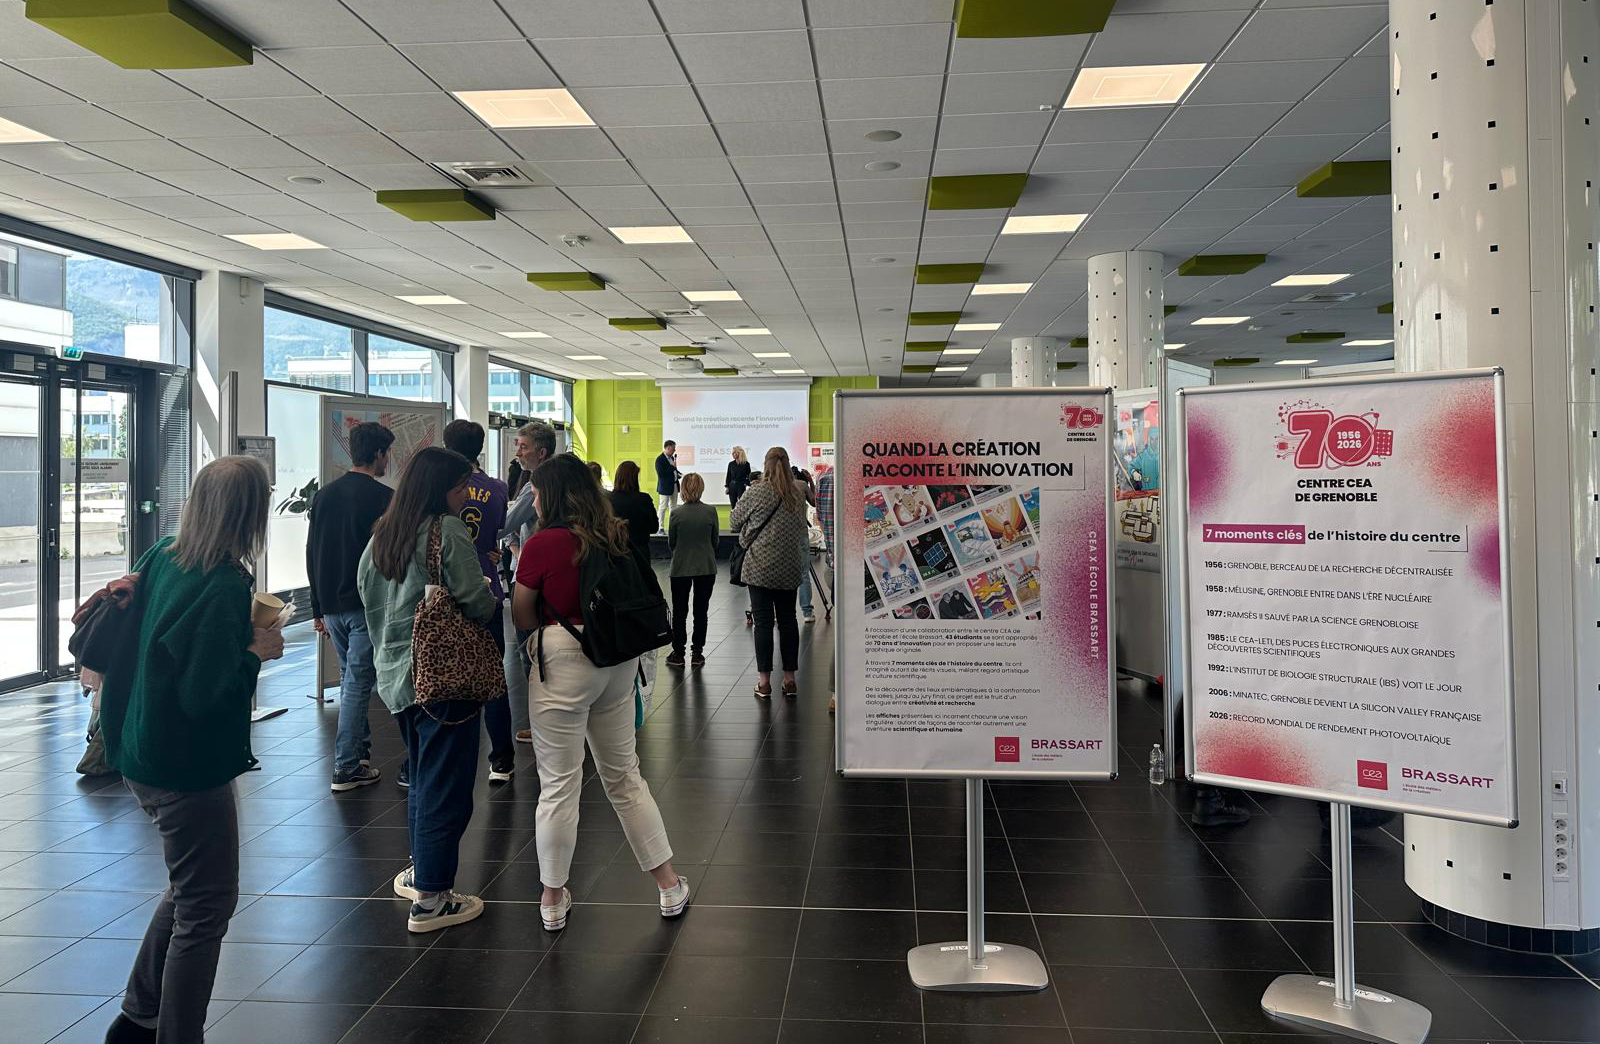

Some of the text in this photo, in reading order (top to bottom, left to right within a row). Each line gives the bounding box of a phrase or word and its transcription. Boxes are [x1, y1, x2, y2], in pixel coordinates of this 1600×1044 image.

[1288, 409, 1374, 469] 70
[1337, 431, 1360, 440] 1956
[1337, 440, 1362, 449] 2026
[862, 439, 1040, 458] QUAND LA CRÉATION
[863, 462, 1073, 477] RACONTE L'INNOVATION
[1297, 478, 1372, 488] CENTRE CEA
[468, 487, 491, 503] MES
[1295, 492, 1378, 502] DE GRENOBLE
[1089, 531, 1097, 552] CEA
[1206, 529, 1460, 542] 7 moments clés de l'histoire du centre
[1227, 562, 1269, 571] GRENOBLE,
[1270, 563, 1307, 572] BERCEAU
[1332, 566, 1382, 574] RECHERCHE
[1385, 566, 1453, 576] DÉCENTRALISÉE
[1090, 566, 1100, 600] ÉCOLE
[1228, 586, 1266, 596] MÉLUSINE,
[1267, 588, 1308, 598] GRENOBLE
[1310, 590, 1335, 599] ENTRE
[1337, 591, 1361, 600] DANS
[1385, 592, 1432, 603] NUCLÉAIRE
[1227, 610, 1258, 620] RAMSÈS
[1264, 612, 1290, 622] SAUVÉ
[1292, 615, 1308, 623] PAR
[1310, 616, 1320, 624] LA
[1321, 616, 1357, 626] SCIENCE
[1359, 618, 1419, 629] GRENOBLOISE
[1090, 603, 1099, 659] BRASSART
[1208, 642, 1320, 659] DÉCOUVERTES SCIENTIFIQUES
[1276, 638, 1291, 647] DES
[1292, 639, 1319, 649] PUCES
[1321, 640, 1389, 654] ÉLECTRONIQUES
[1391, 647, 1409, 655] AUX
[1411, 648, 1455, 658] GRANDES
[1268, 669, 1278, 677] DE
[1280, 670, 1316, 681] BIOLOGIE
[1319, 673, 1377, 686] STRUCTURALE
[1379, 678, 1400, 689] (IBS)
[1402, 680, 1422, 690] VOIT
[1425, 682, 1435, 691] LE
[1436, 684, 1462, 693] JOUR
[1233, 691, 1270, 702] MINATEC,
[1271, 694, 1312, 706] GRENOBLE
[1313, 698, 1347, 708] DEVIENT
[1349, 702, 1359, 710] LA
[1361, 703, 1395, 714] SILICON
[1397, 706, 1428, 717] VALLEY
[1430, 710, 1482, 722] FRANÇAISE
[1232, 714, 1265, 724] RECORD
[1267, 718, 1304, 729] MONDIAL
[1305, 722, 1316, 730] DE
[1318, 724, 1367, 735] RENDEMENT
[1369, 728, 1451, 745] PHOTOVOLTAÏQUE
[1031, 739, 1103, 750] BRASSART
[1402, 768, 1494, 788] BRASSART
